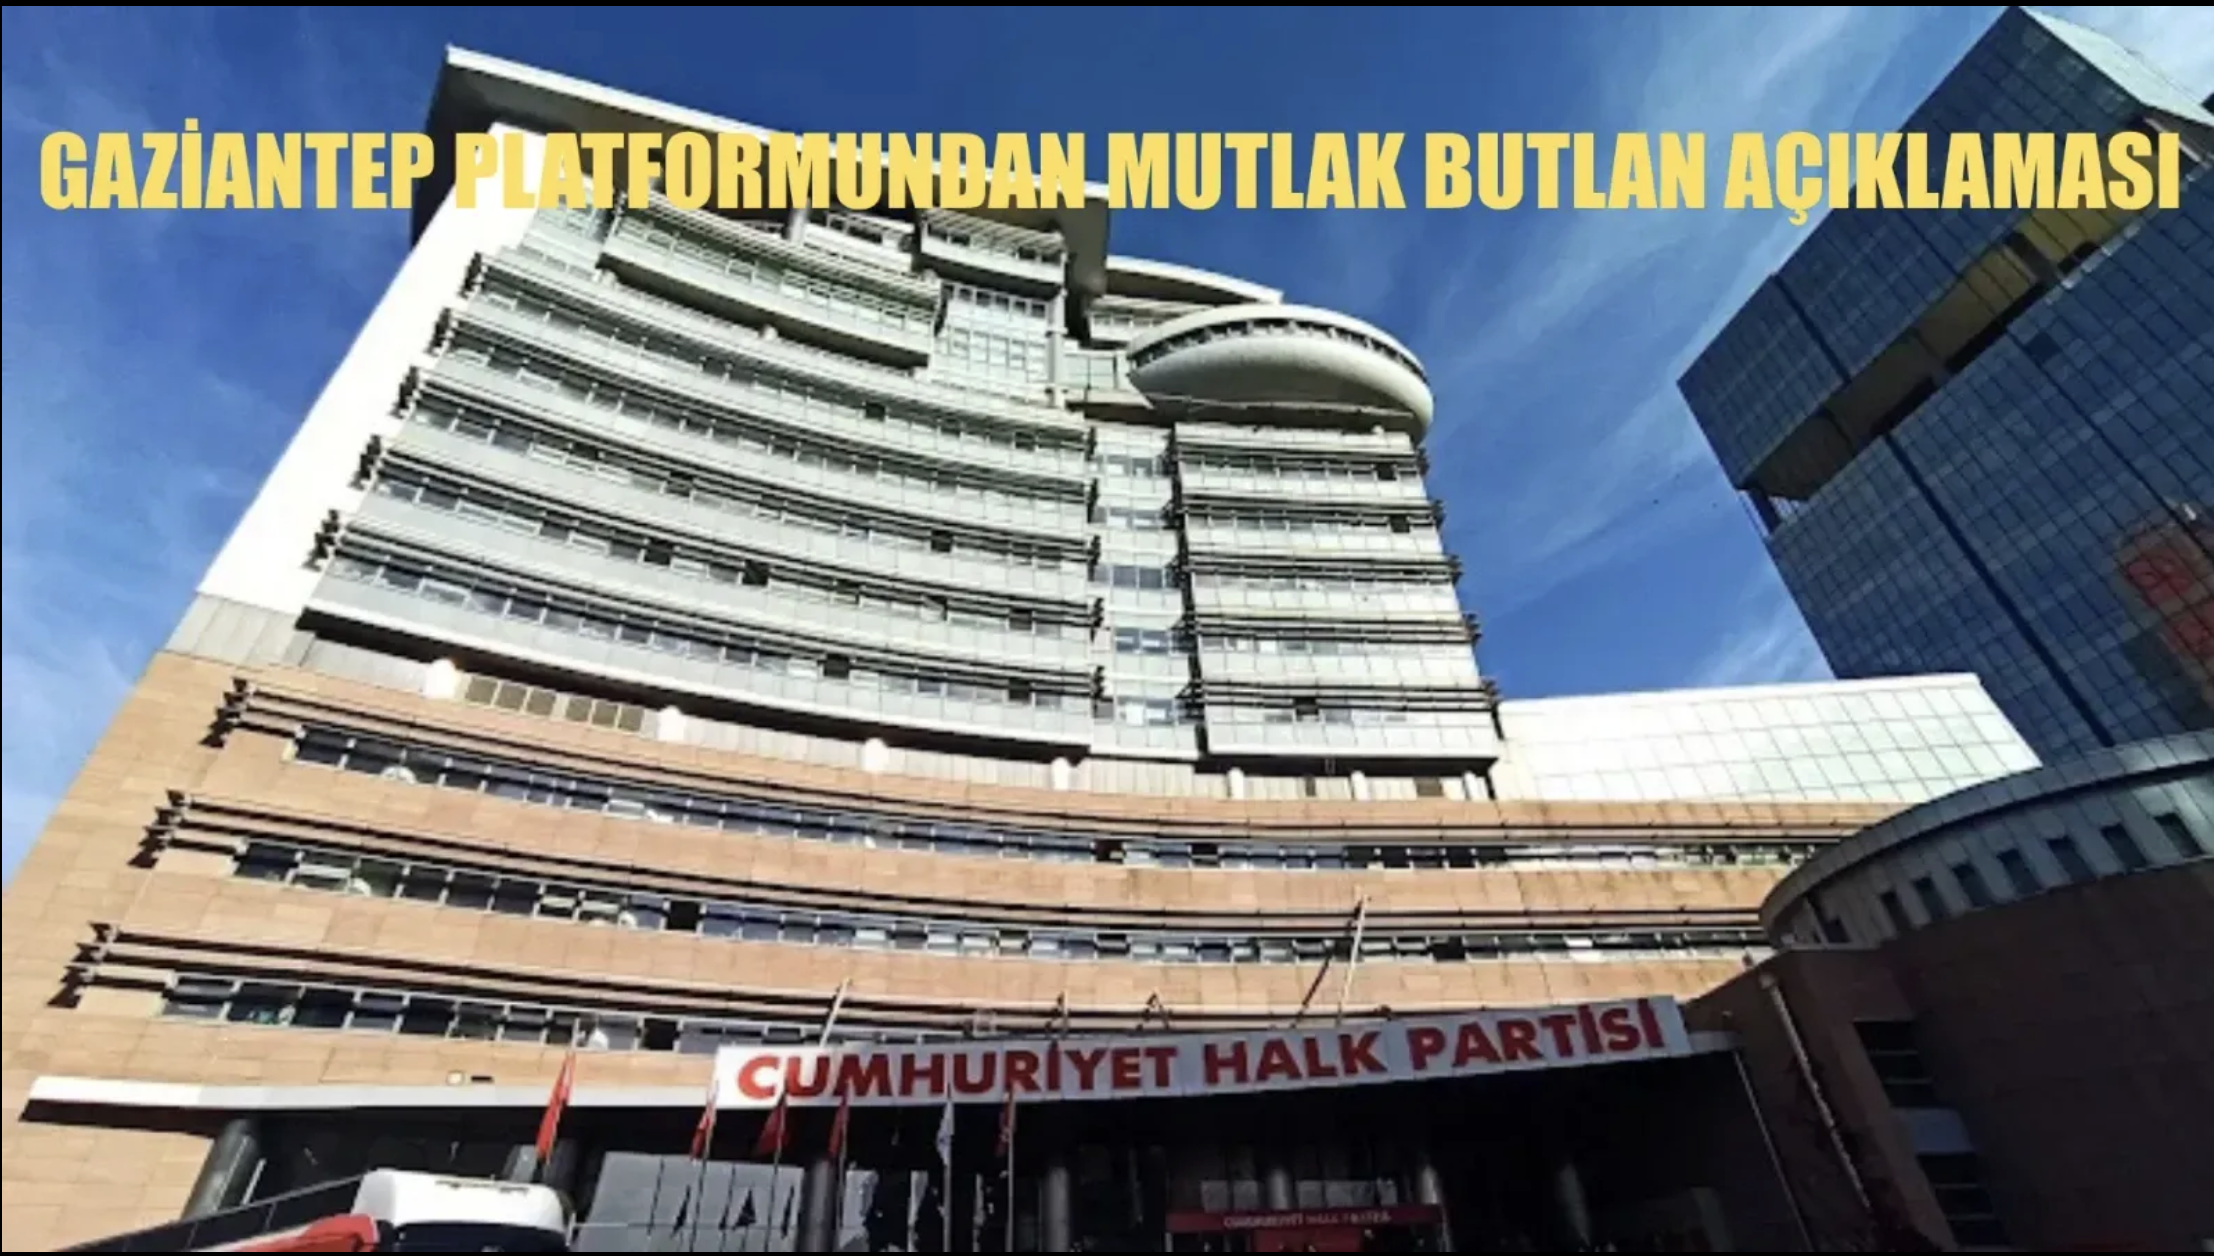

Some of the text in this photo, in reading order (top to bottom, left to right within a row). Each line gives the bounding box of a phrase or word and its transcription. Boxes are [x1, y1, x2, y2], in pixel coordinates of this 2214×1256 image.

[737, 1000, 1665, 1099] CUMHURİYET HALK PARTİSİ
